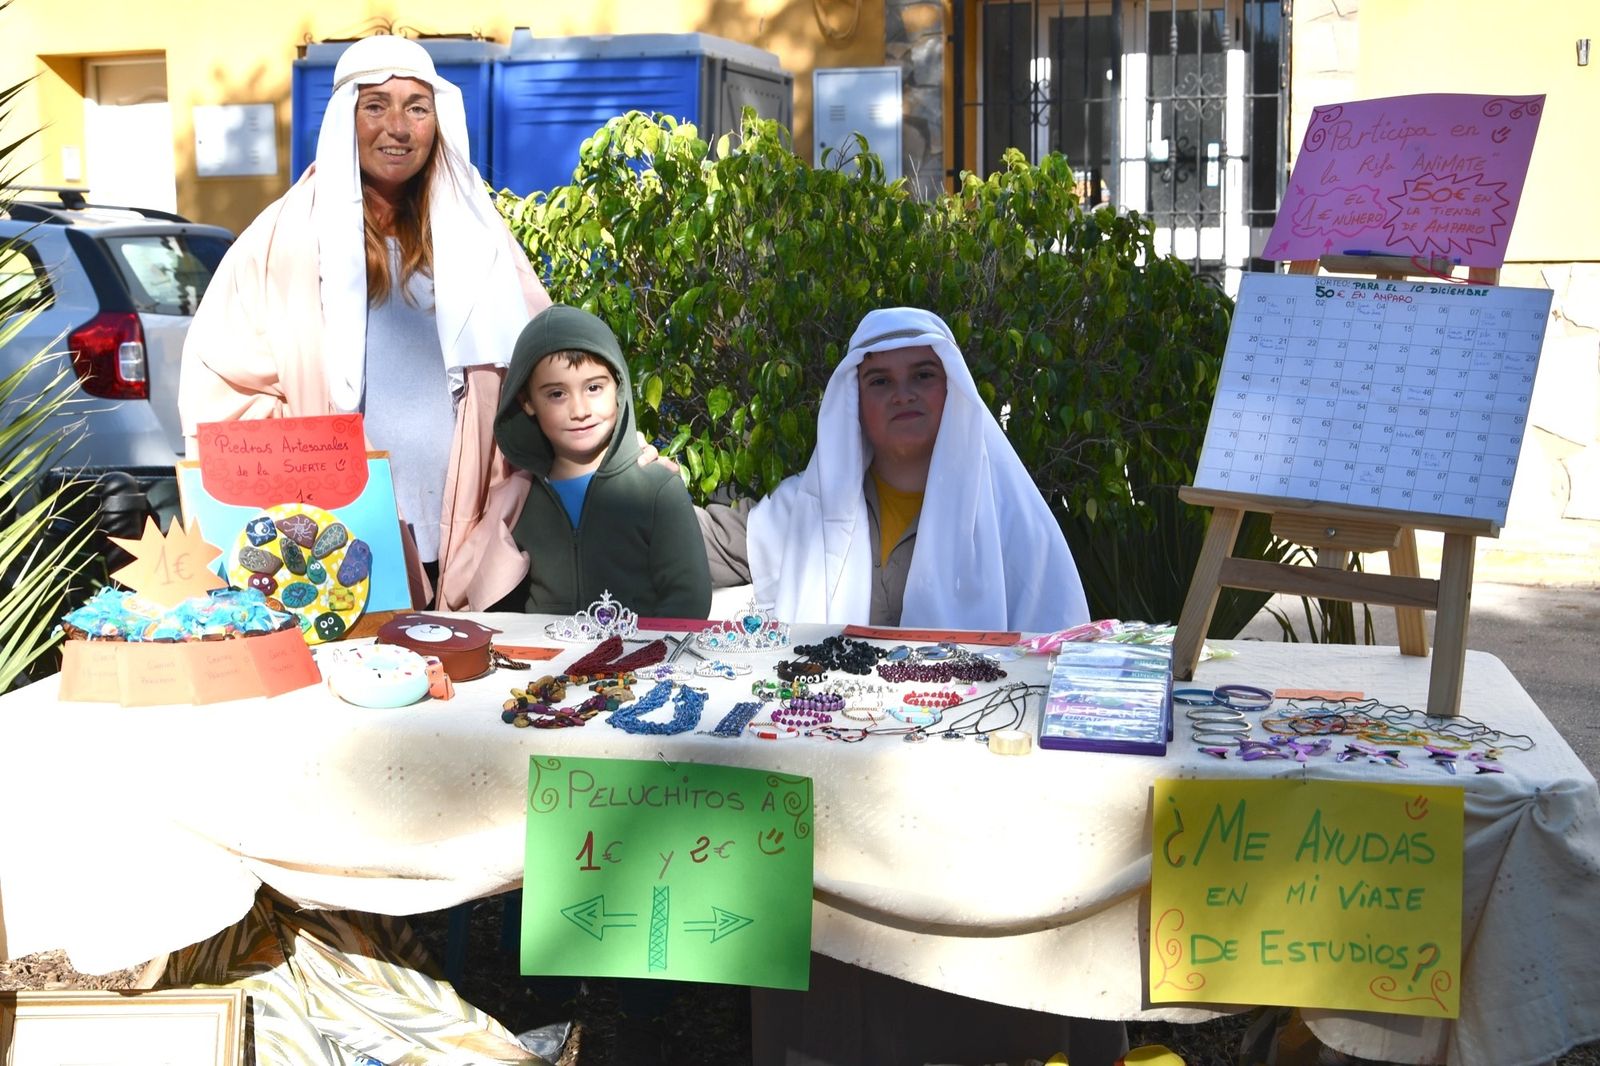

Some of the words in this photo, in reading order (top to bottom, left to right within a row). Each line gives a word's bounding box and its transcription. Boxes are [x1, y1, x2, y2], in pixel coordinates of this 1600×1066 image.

[1328, 112, 1436, 151] Participa
[1450, 125, 1479, 137] en
[1321, 159, 1340, 185] la
[1344, 193, 1363, 205] EL
[1473, 193, 1492, 203] EN
[1406, 206, 1421, 216] LA
[1402, 222, 1417, 231] DE
[1424, 219, 1487, 233] AMPARO
[1353, 281, 1379, 291] PARA
[1386, 283, 1398, 293] EL
[1410, 285, 1424, 293] 10
[1351, 290, 1366, 299] EN
[1374, 292, 1413, 304] AMPARO
[214, 434, 273, 454] Piedras
[283, 435, 349, 454] Artesanales
[237, 465, 249, 477] de
[257, 464, 270, 476] la
[284, 459, 327, 473] SUERTE
[760, 791, 776, 813] A
[1295, 808, 1436, 865] AYUDAS
[1206, 882, 1249, 907] EN
